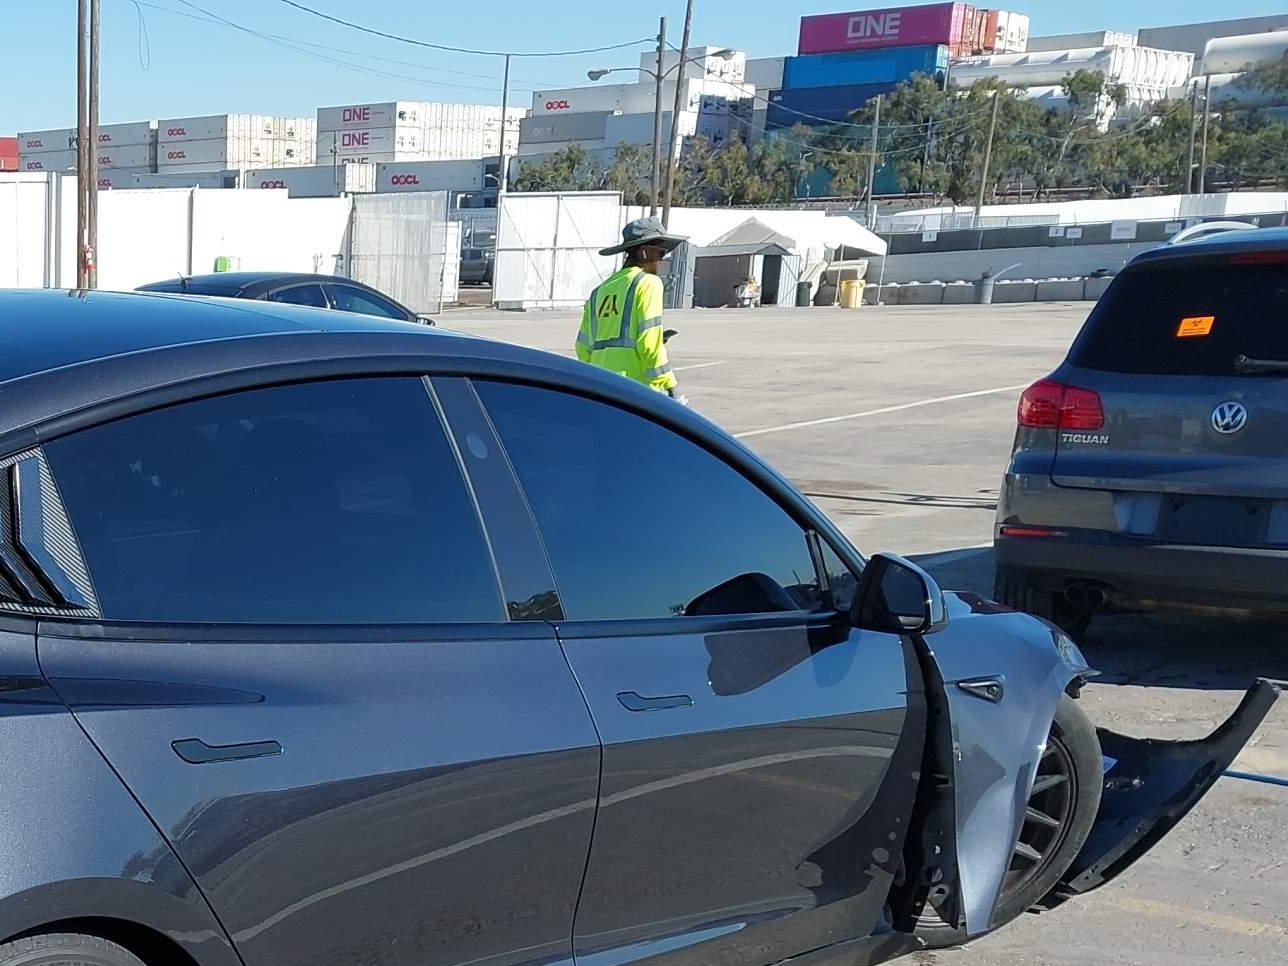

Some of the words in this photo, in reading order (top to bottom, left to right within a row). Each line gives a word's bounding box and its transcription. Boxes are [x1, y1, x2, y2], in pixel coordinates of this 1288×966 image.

[847, 13, 901, 38] ONE
[546, 100, 570, 110] OOCL
[343, 107, 370, 122] ONE
[167, 128, 186, 136] OOCL
[98, 134, 111, 142] OCL
[342, 132, 369, 147] ONE
[167, 151, 186, 159] OOCL
[98, 156, 111, 165] OCL
[98, 178, 111, 187] OCL
[391, 174, 420, 185] OOCL
[1062, 433, 1109, 444] TIGUAN
